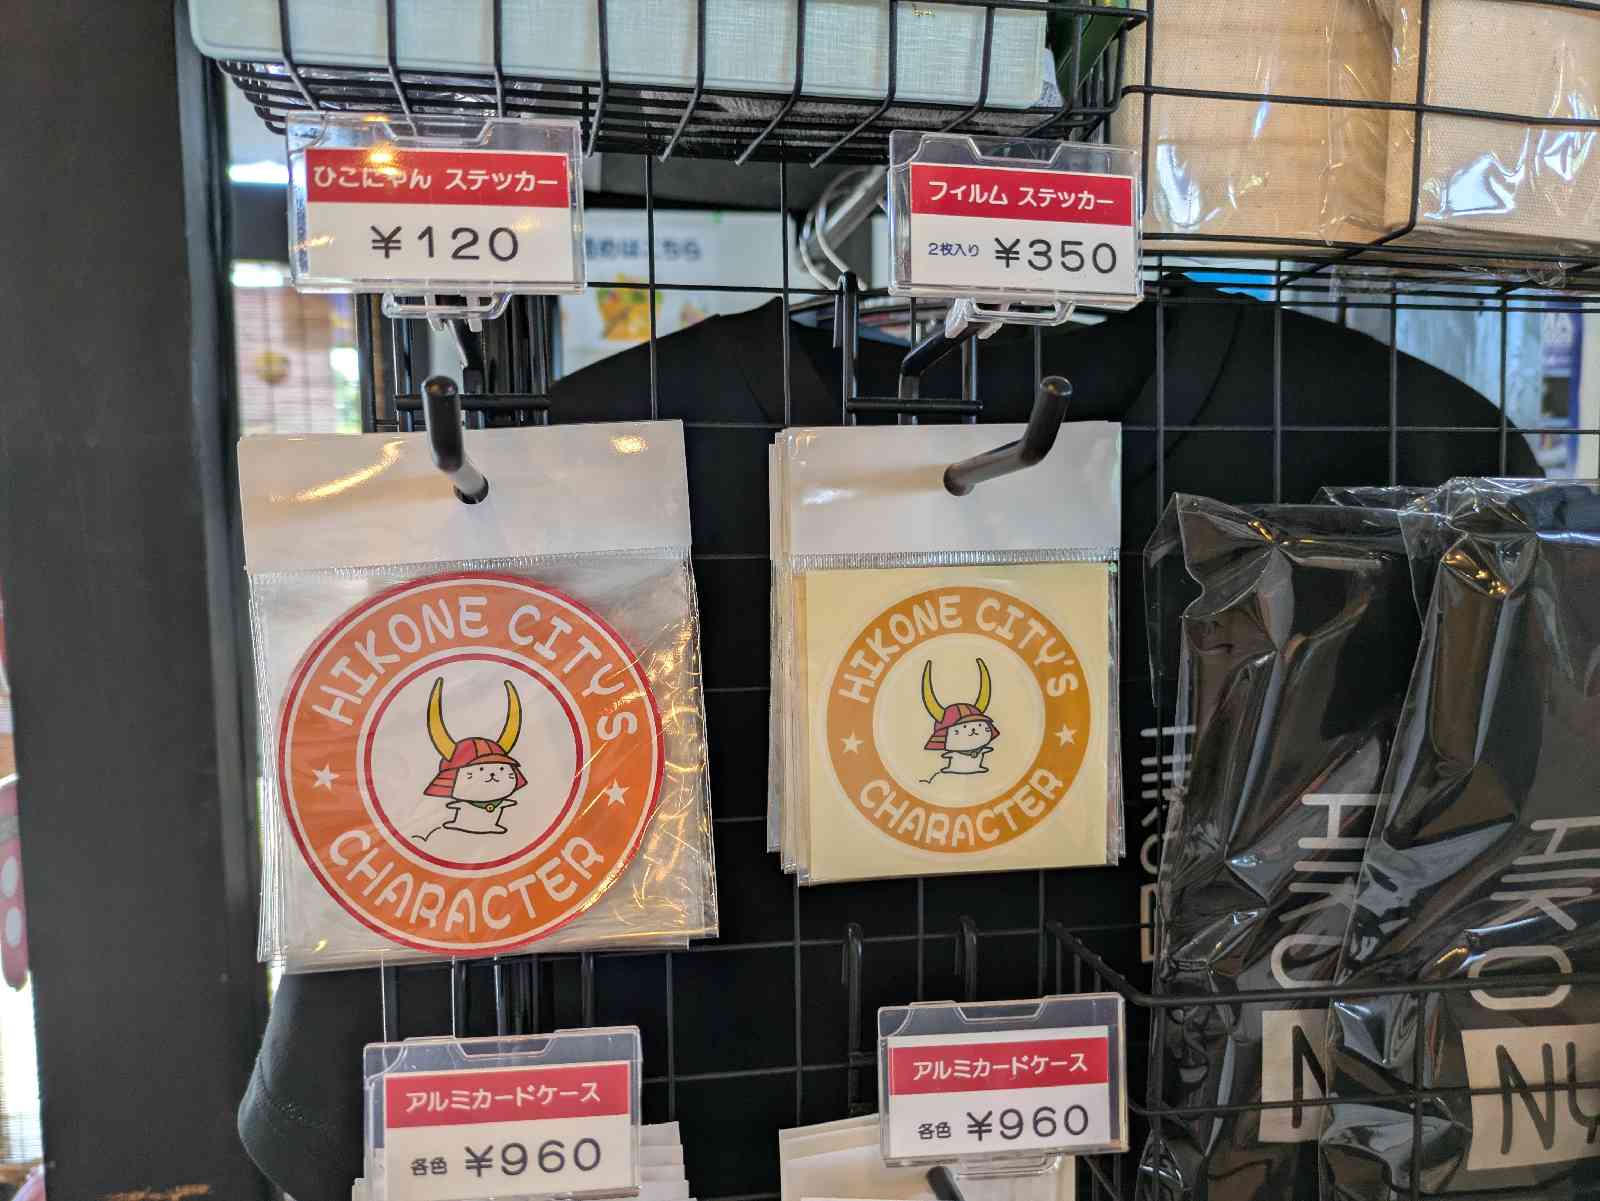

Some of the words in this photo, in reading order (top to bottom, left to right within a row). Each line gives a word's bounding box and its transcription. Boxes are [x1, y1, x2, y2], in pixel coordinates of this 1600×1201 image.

[314, 165, 431, 189] ひこにゃん
[445, 168, 558, 192] ステッカー
[929, 181, 1008, 205] フィルム
[1018, 187, 1114, 210] ステッカー
[371, 225, 519, 262] ¥120
[928, 242, 979, 257] 2枚入り
[994, 237, 1117, 274] ¥350
[839, 595, 962, 704] HIKONE
[975, 597, 1078, 697] CITY'S
[311, 596, 489, 726] HIKONE
[508, 605, 638, 741] CITYS
[860, 768, 1063, 847] CHARACTER
[329, 830, 604, 933] CHARACTER
[913, 1053, 1088, 1080] アルミカードケース
[406, 1082, 600, 1113] アルミカードケース
[918, 1122, 951, 1140] 各色
[967, 1104, 1089, 1141] ¥960
[410, 1156, 448, 1176] 各色
[464, 1138, 601, 1177] ¥960
